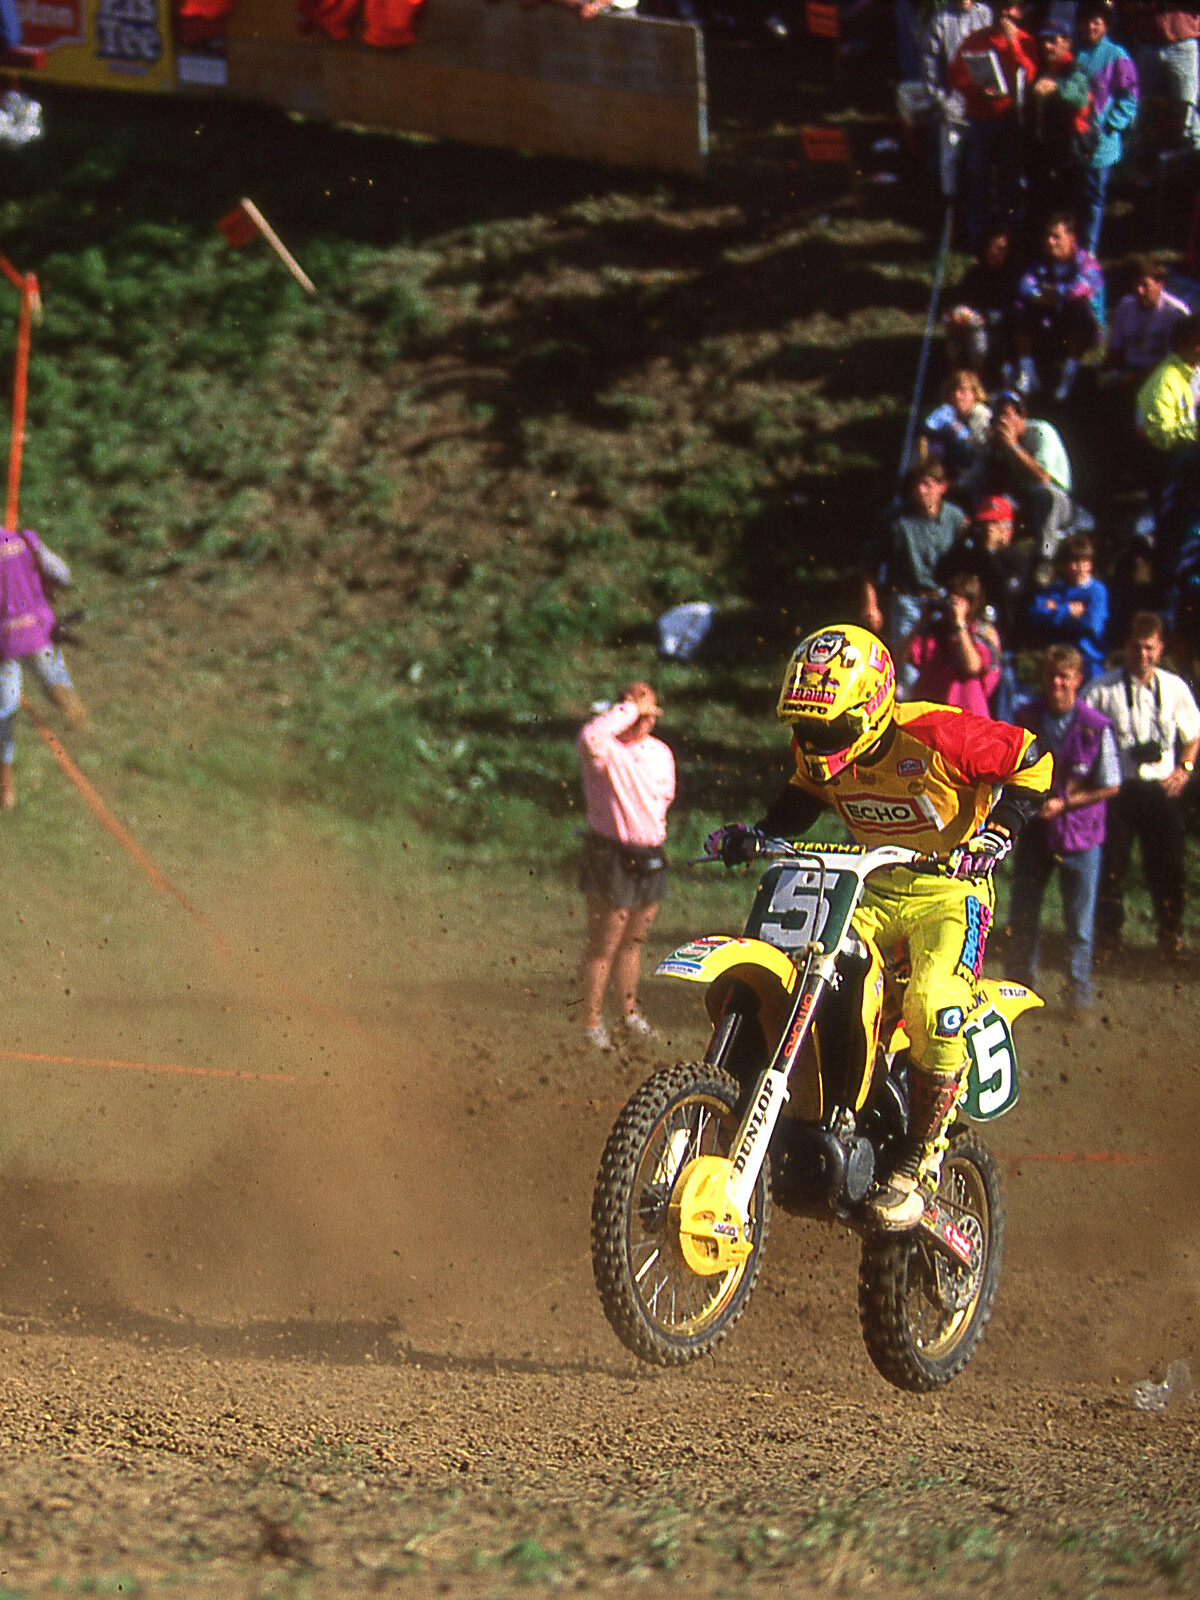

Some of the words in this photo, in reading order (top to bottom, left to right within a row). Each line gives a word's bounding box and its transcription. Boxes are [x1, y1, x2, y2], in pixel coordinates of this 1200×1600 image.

[846, 803, 910, 821] ECHO
[760, 870, 840, 948] 5
[972, 1019, 1012, 1114] 5
[733, 1077, 774, 1175] DUNLOP
